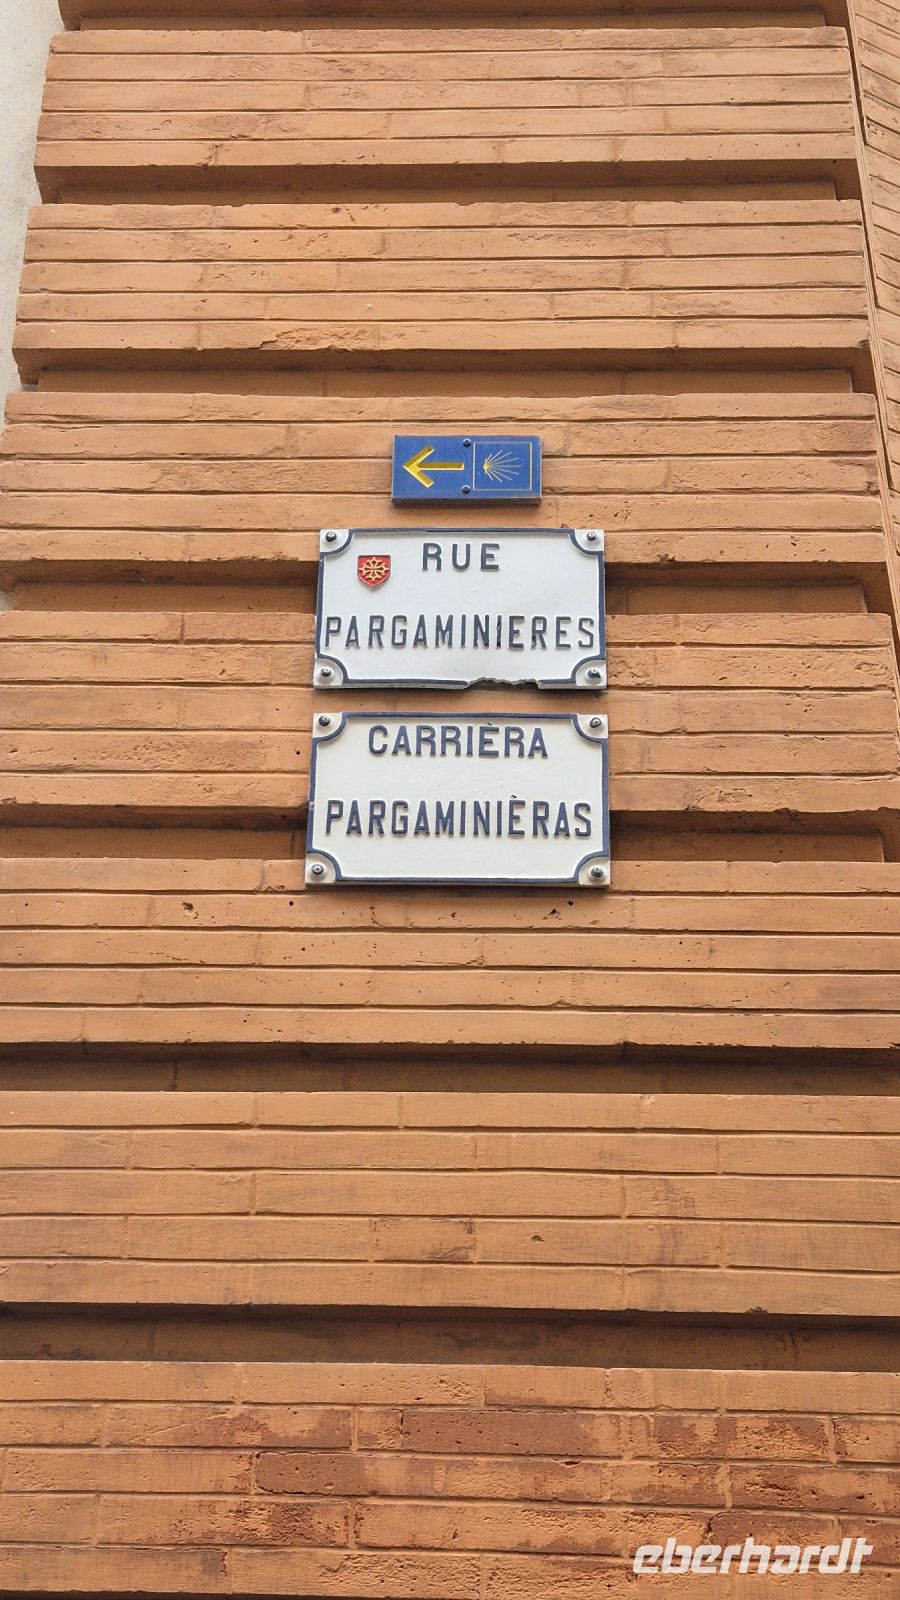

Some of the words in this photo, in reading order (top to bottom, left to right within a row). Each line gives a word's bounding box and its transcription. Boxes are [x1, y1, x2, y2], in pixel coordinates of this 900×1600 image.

[422, 543, 500, 572] RUE
[325, 615, 594, 649] PARGAMINIERES
[368, 722, 548, 757] CARRIÈRA
[325, 795, 592, 837] PARGAMINIÈRAS
